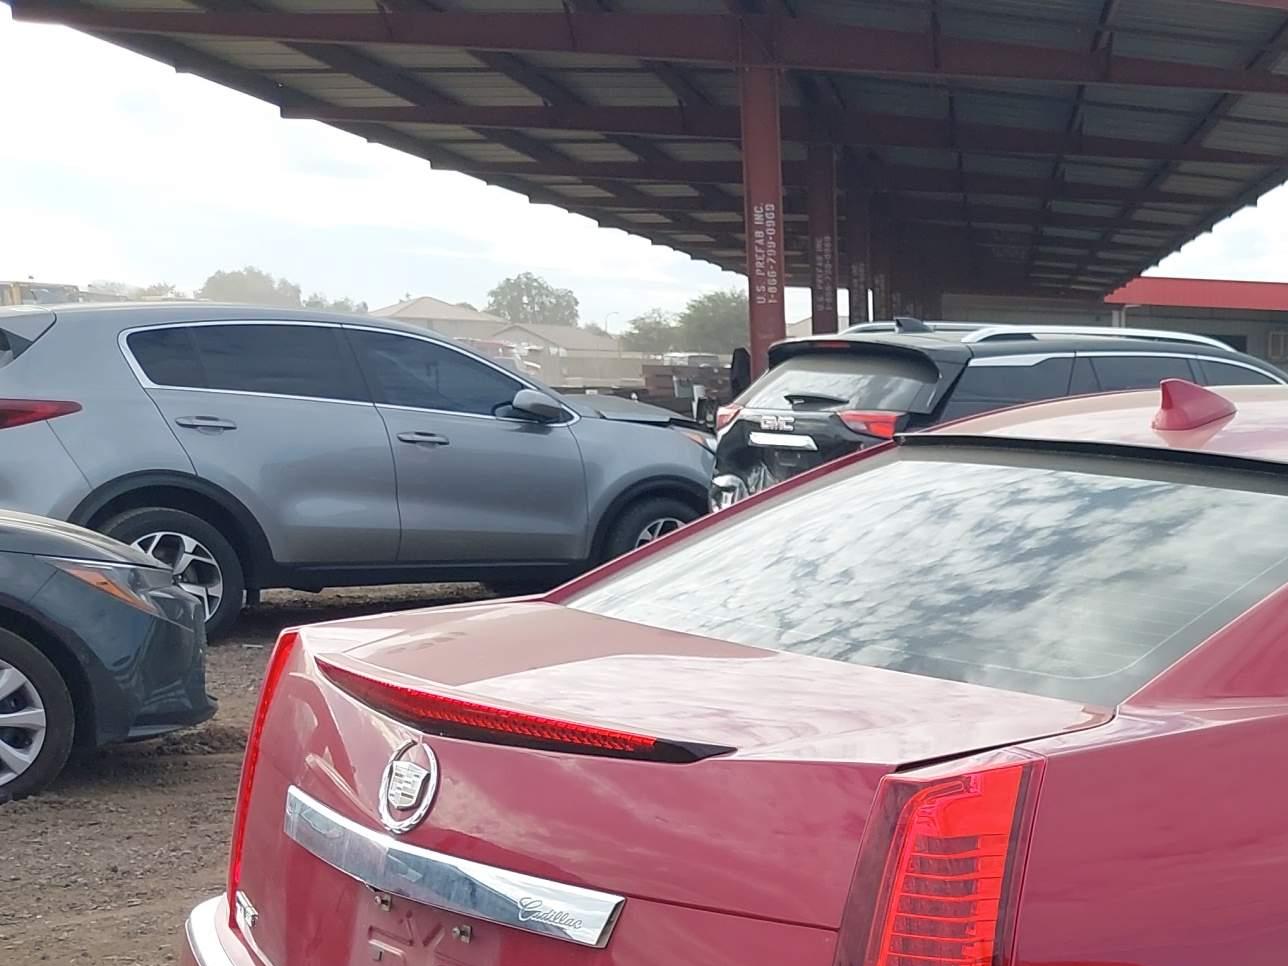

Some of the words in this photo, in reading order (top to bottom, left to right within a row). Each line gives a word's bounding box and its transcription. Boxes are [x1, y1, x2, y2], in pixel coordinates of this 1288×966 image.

[754, 230, 766, 276] PREFAB
[755, 280, 767, 304] U.S.
[760, 415, 795, 431] GMC
[519, 896, 584, 930] Cadillac
